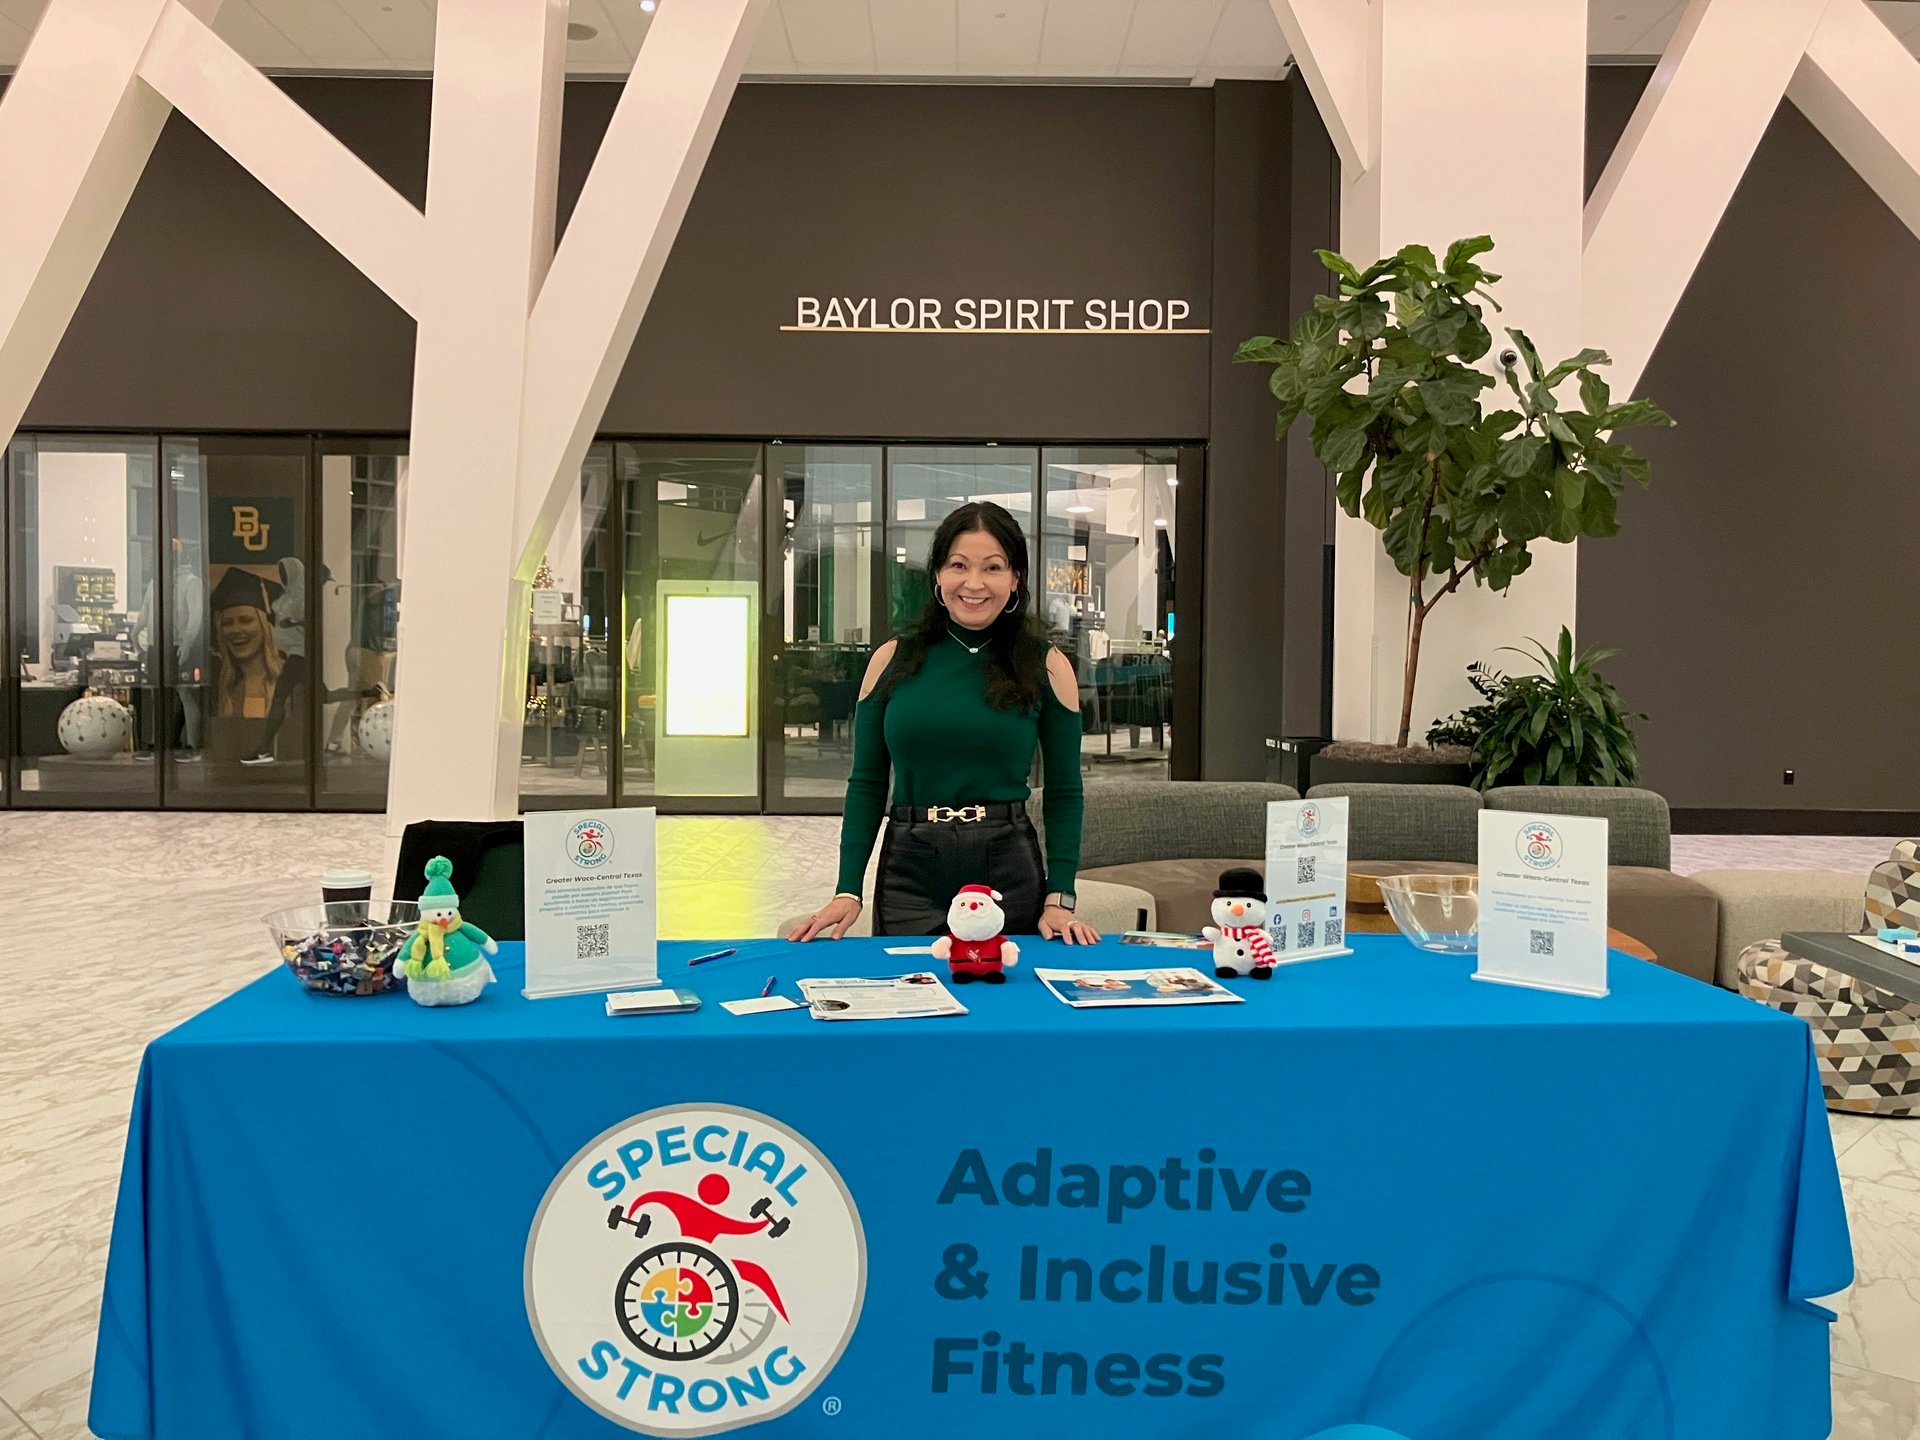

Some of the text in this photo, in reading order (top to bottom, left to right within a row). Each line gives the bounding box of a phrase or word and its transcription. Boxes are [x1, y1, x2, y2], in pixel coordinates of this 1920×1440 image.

[797, 296, 1190, 331] BAYLOR SPIRIT SHOP
[232, 505, 270, 551] BU
[573, 821, 605, 835] SPECIAL
[1523, 824, 1554, 837] SPECIAL
[573, 853, 607, 866] STRONG
[574, 873, 622, 882] Waco-Central
[1523, 854, 1555, 867] STRONG
[586, 1125, 808, 1208] SPECIAL
[936, 1147, 1312, 1225] Adaptive
[934, 1242, 1381, 1307] & Inclusive
[577, 1340, 807, 1415] STRONG
[931, 1330, 1226, 1398] Fitness
